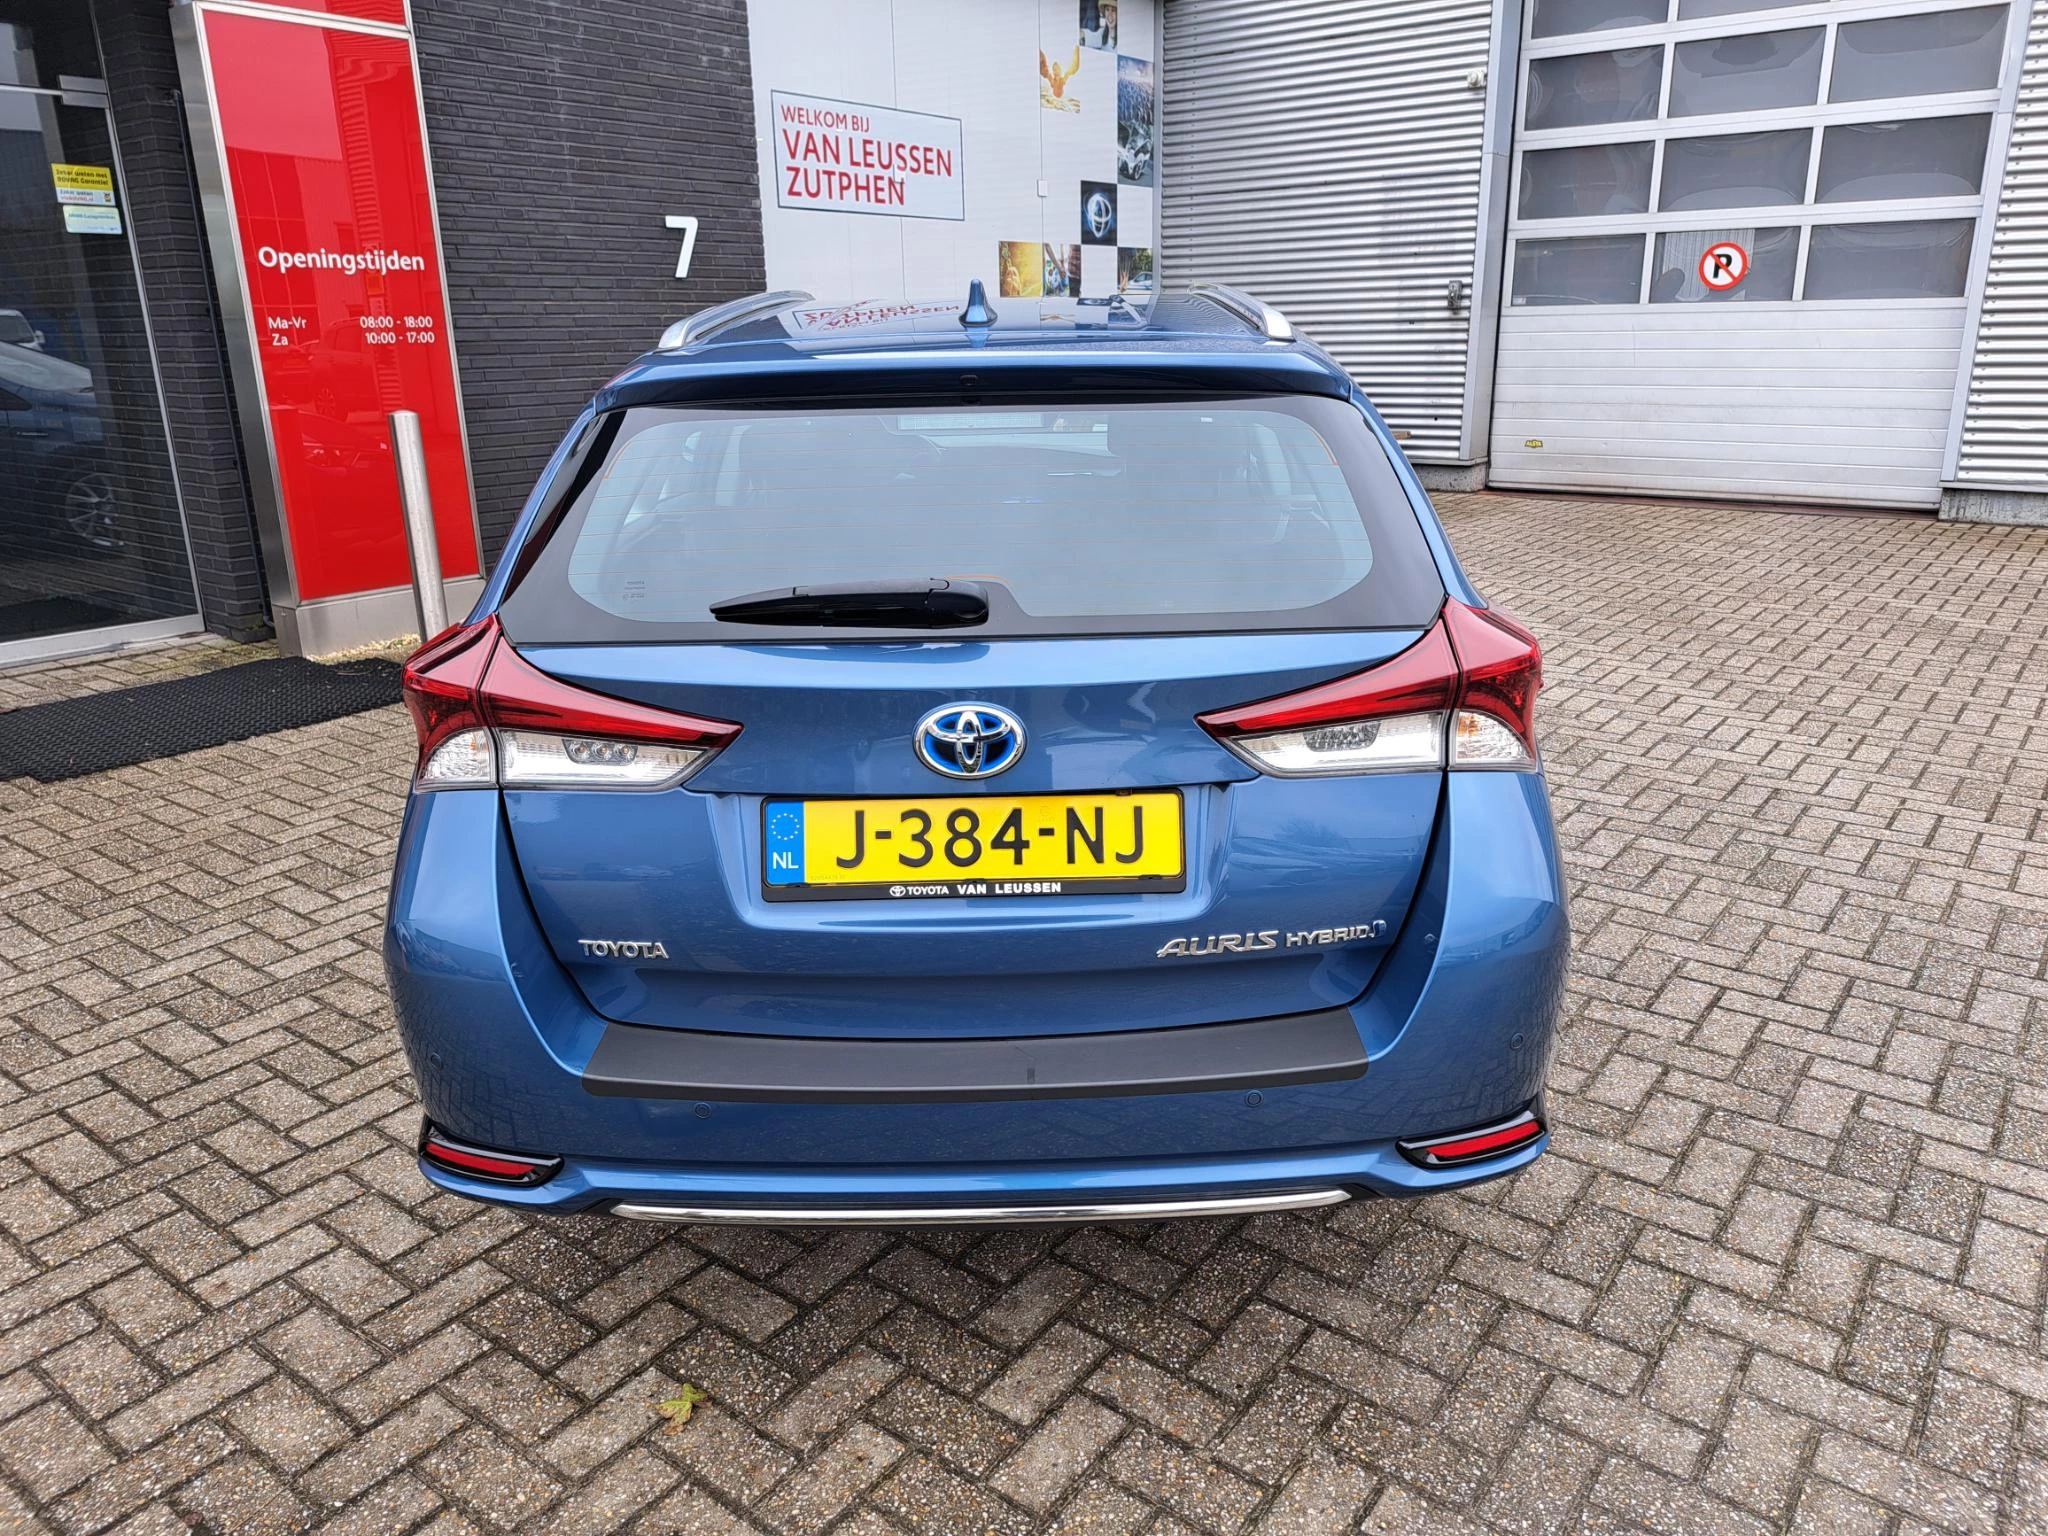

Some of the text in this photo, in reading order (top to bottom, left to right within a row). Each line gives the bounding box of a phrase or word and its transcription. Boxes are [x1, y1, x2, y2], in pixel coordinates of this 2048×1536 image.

[781, 105, 870, 133] WELKOM BIJ
[782, 128, 952, 177] VAN LEUSSEN
[786, 166, 905, 205] ZUTPHEN
[258, 246, 425, 275] Openingstijden
[665, 215, 699, 278] 7
[268, 316, 307, 329] Ma-Vr
[359, 315, 394, 329] 08:00
[404, 315, 433, 328] 18:00
[272, 333, 289, 346] Za
[365, 331, 396, 344] 10:00
[406, 331, 435, 344] 17:00
[836, 806, 1143, 868] J-384-NJ
[772, 851, 799, 870] NL
[907, 882, 1061, 896] TOYOTA VAN LEUSSEN
[578, 940, 669, 959] TOYOTA
[1156, 925, 1370, 958] AURIS HYBRID
